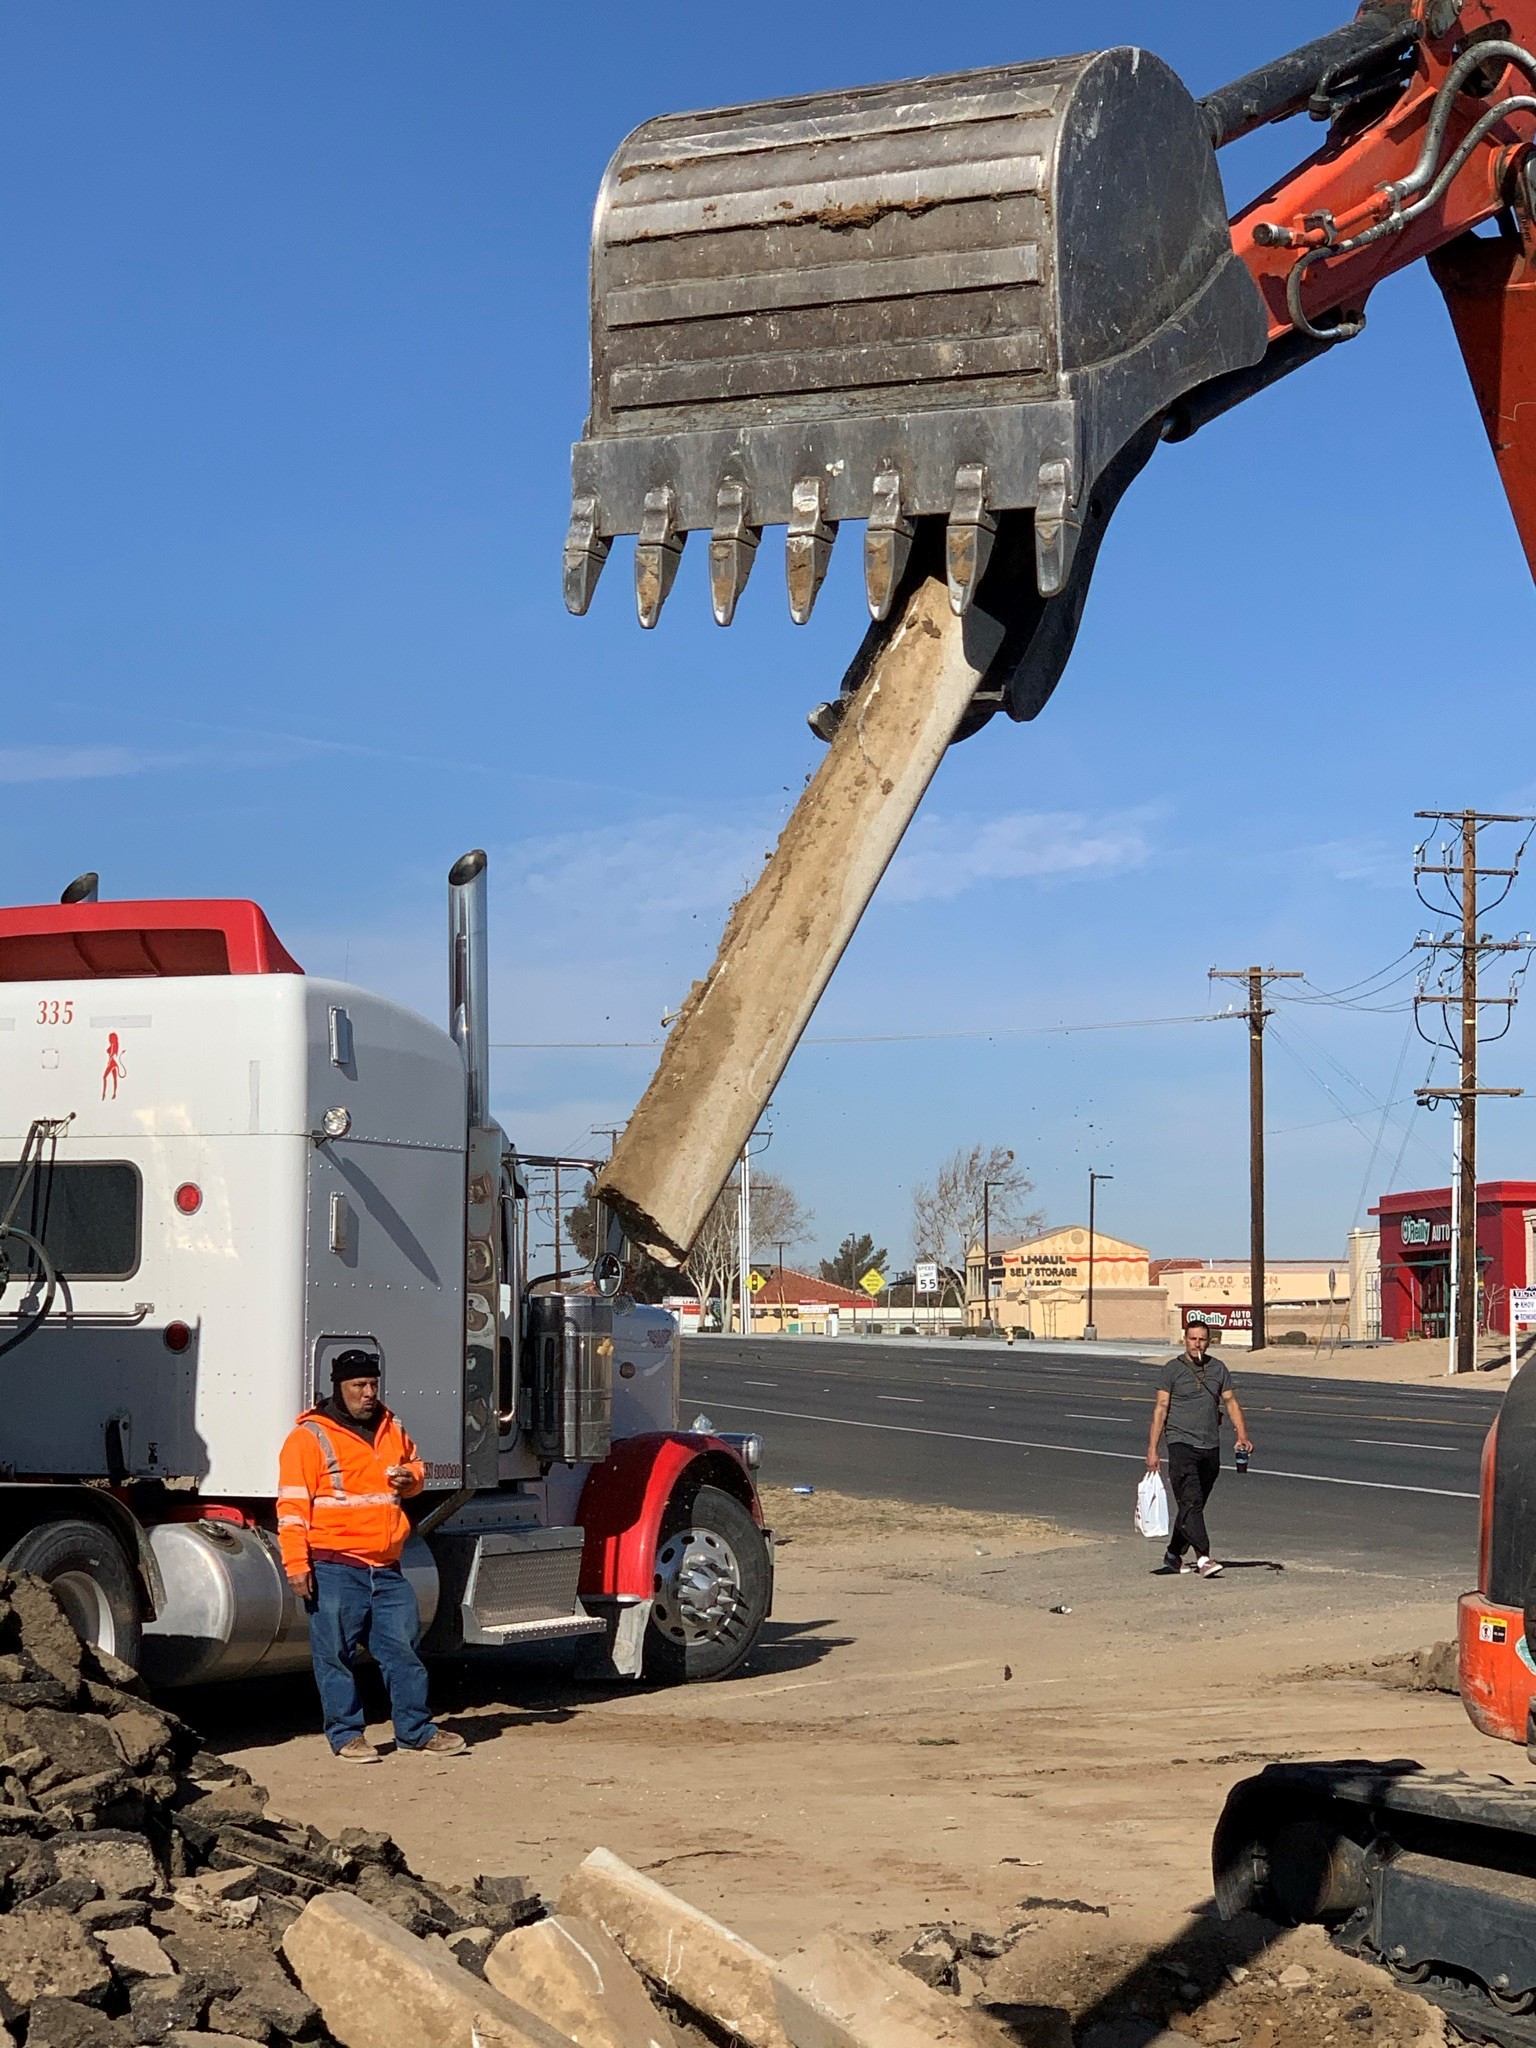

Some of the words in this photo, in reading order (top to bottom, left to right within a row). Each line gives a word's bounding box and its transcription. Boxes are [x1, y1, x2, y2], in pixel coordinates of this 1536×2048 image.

[36, 1000, 73, 1025] 335
[1401, 1216, 1430, 1245] O'Reilly
[1432, 1224, 1450, 1241] AUTO
[1020, 1255, 1066, 1264] U-HAUL
[1009, 1267, 1032, 1277] SELF
[1034, 1267, 1077, 1277] STORAGE
[920, 1279, 936, 1290] 55
[1187, 1310, 1227, 1326] O'Reilly
